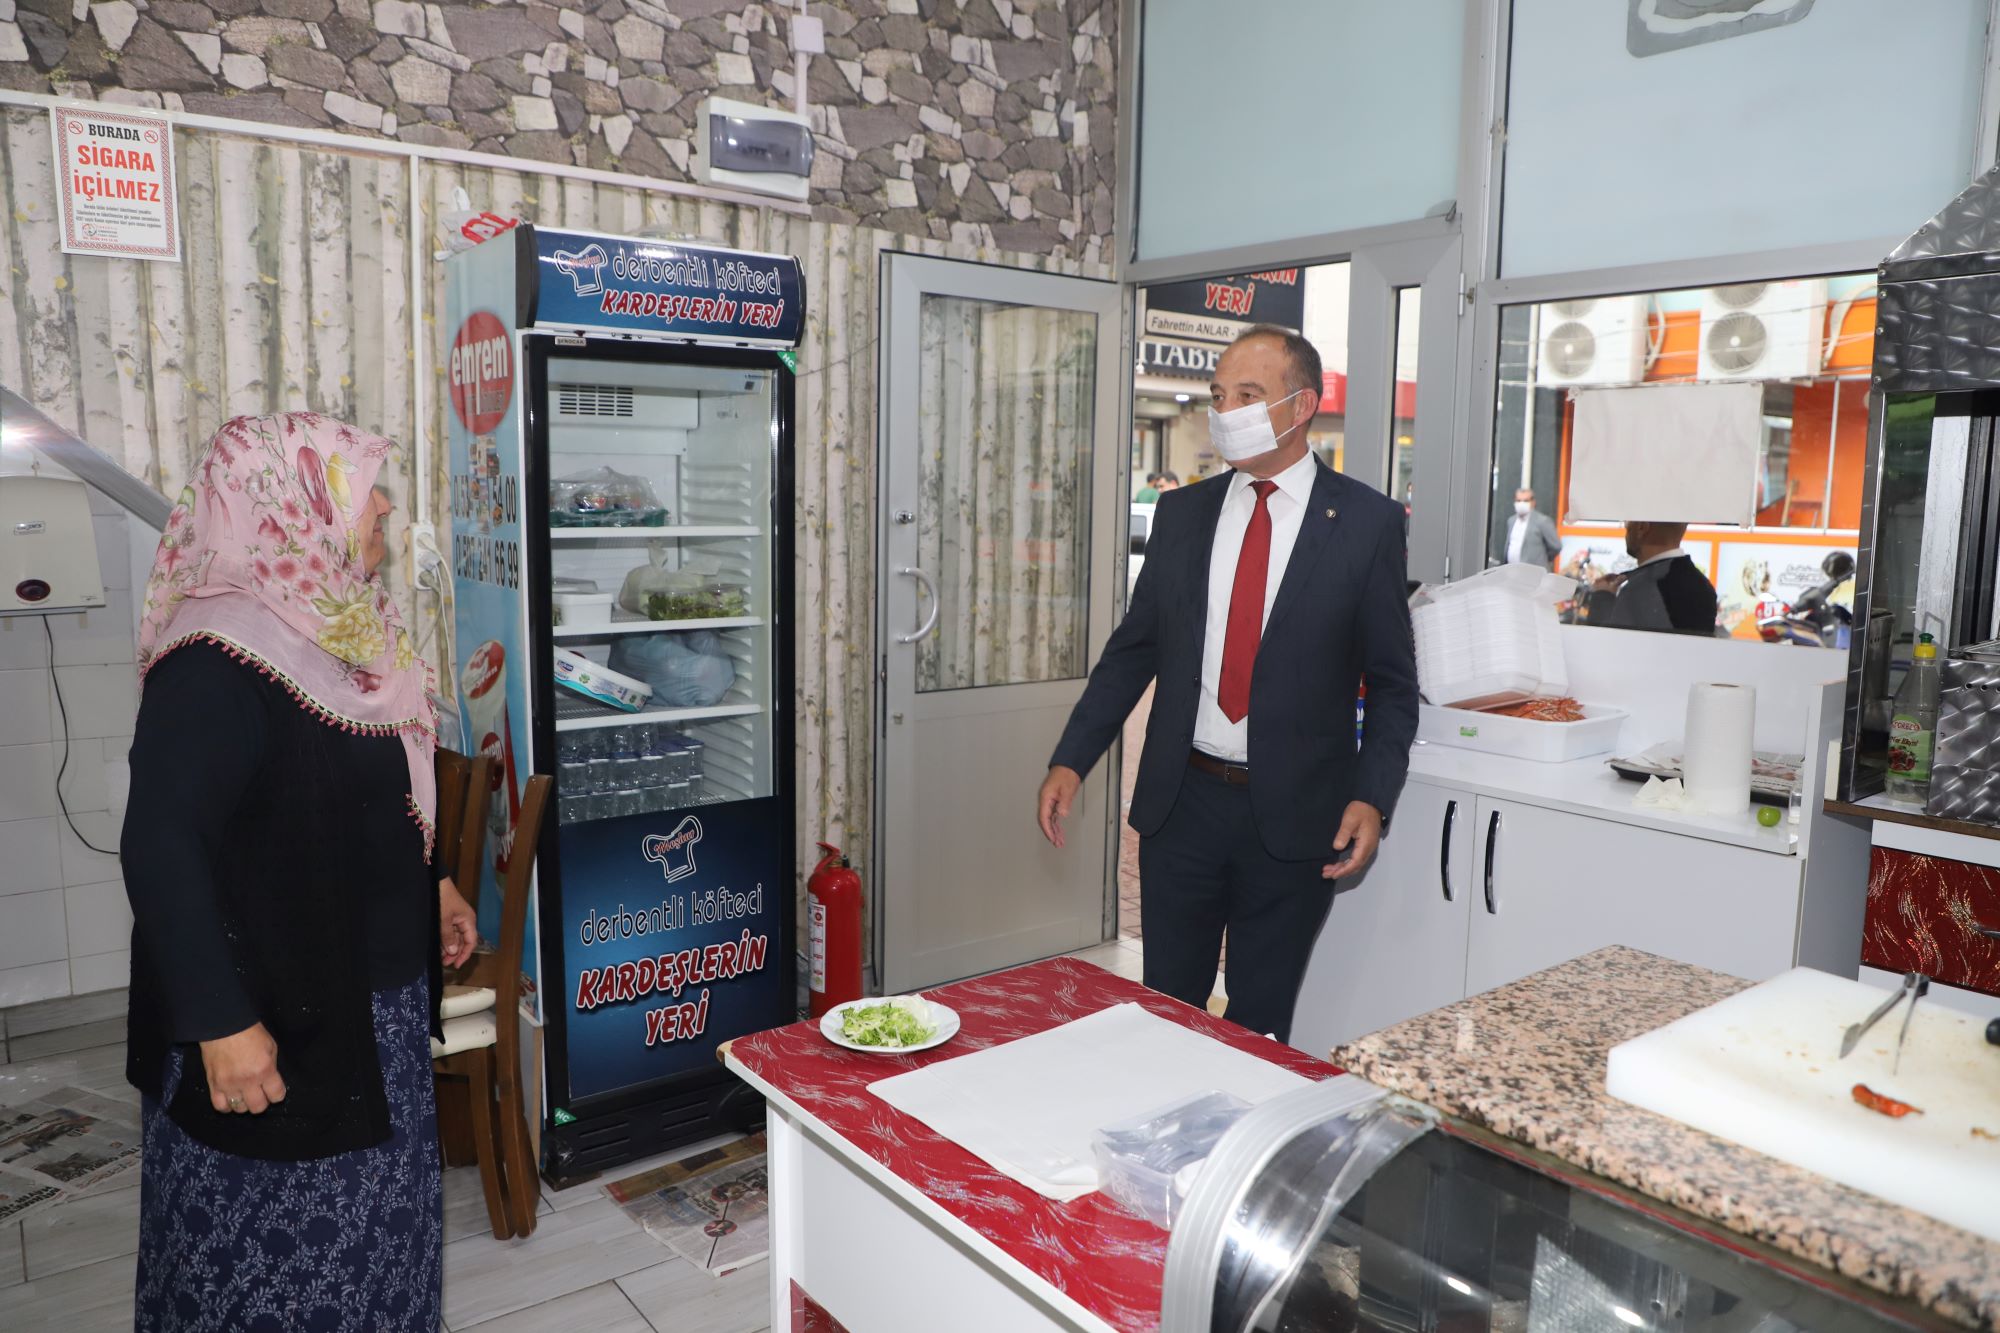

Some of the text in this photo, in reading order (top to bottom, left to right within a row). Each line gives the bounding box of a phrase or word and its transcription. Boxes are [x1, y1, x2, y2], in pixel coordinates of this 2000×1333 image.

[77, 141, 155, 172] SİGARA
[88, 124, 141, 141] BURADA
[74, 169, 161, 203] İÇİLMEZ
[613, 247, 781, 296] derbentli köfteci
[601, 288, 785, 329] KARDEŞLERİN YERİ
[1205, 282, 1255, 316] YERİ
[1151, 316, 1194, 333] Fahrettin
[1195, 323, 1229, 337] ANLAR
[451, 335, 507, 416] emrem
[506, 475, 517, 523] 00
[494, 540, 505, 587] 66
[508, 541, 519, 589] 99
[581, 883, 762, 946] derbentli köfteci
[576, 928, 767, 1009] KARDEŞLERİN
[646, 989, 709, 1046] YERİ
